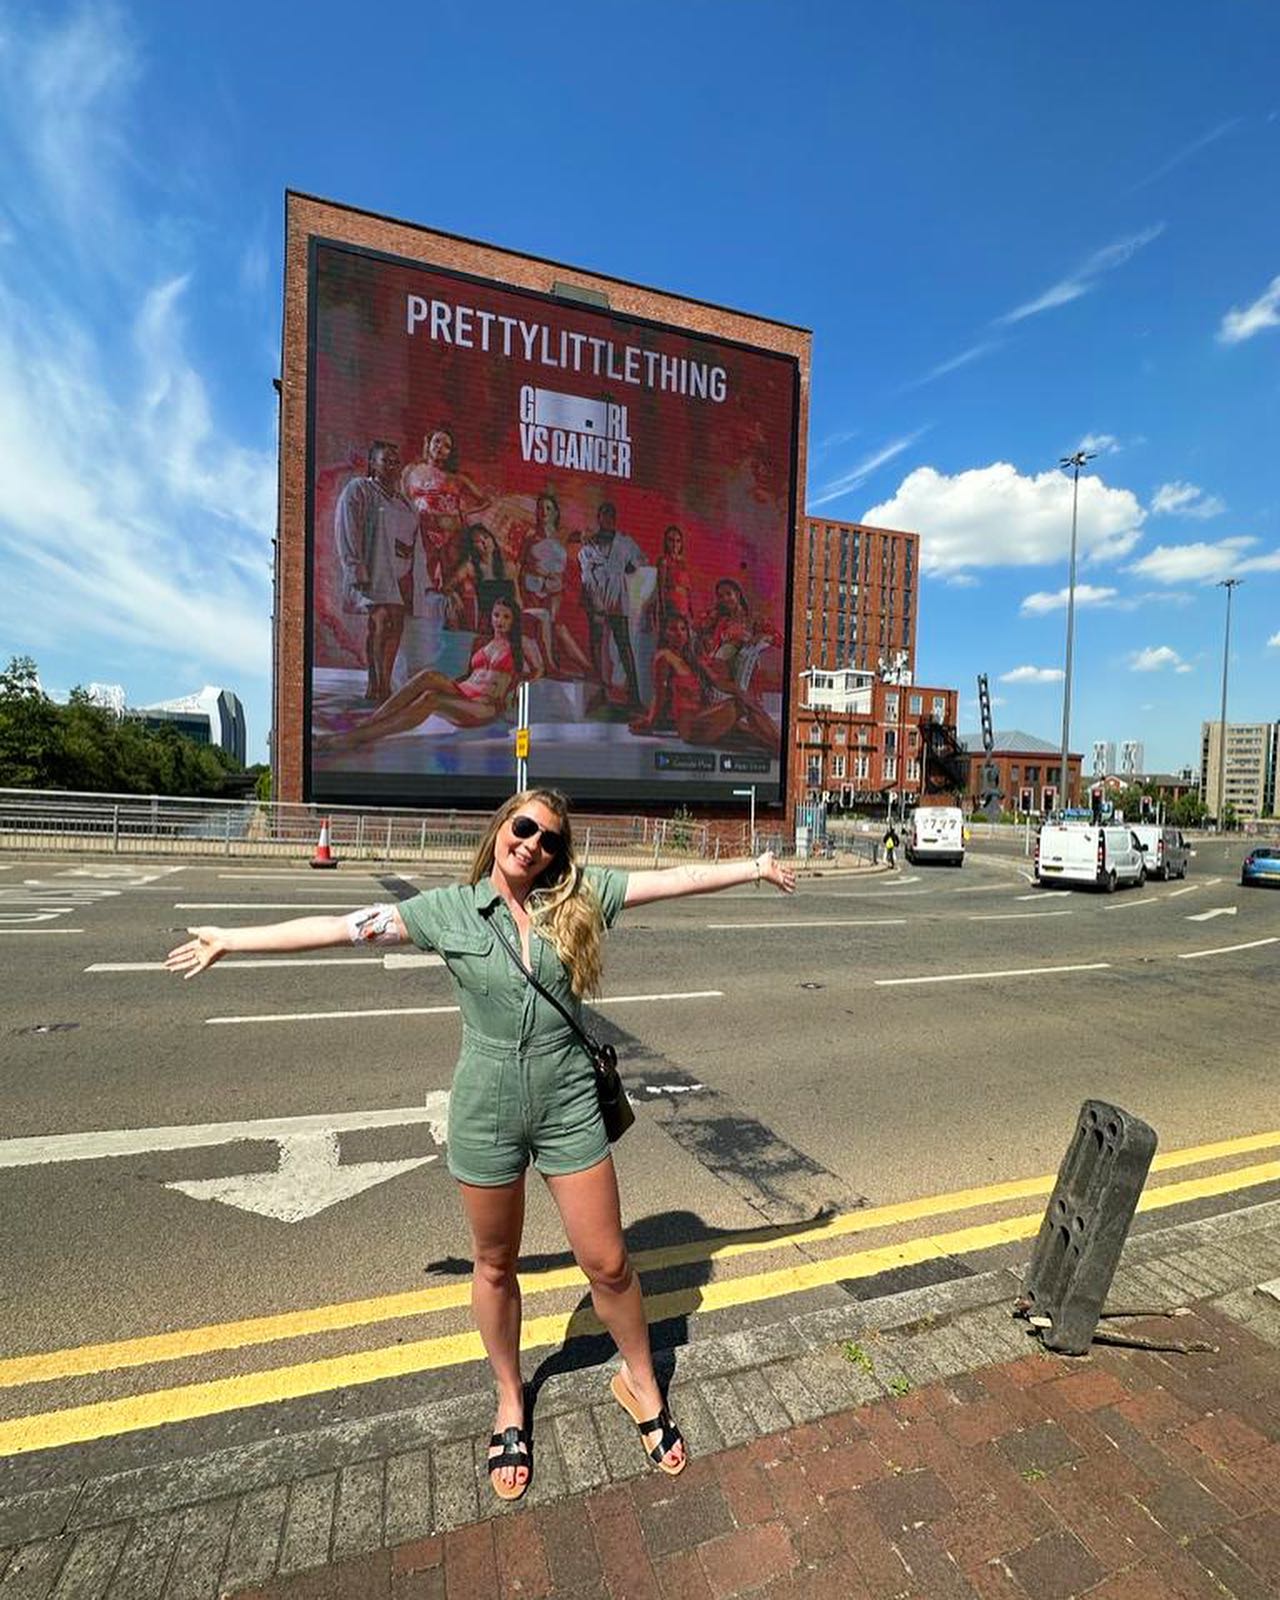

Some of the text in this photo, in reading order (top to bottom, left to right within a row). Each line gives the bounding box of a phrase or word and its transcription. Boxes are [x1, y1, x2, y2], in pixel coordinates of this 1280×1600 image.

[407, 294, 727, 402] PRETTYLITTLETHING
[519, 422, 631, 479] VS CANCER
